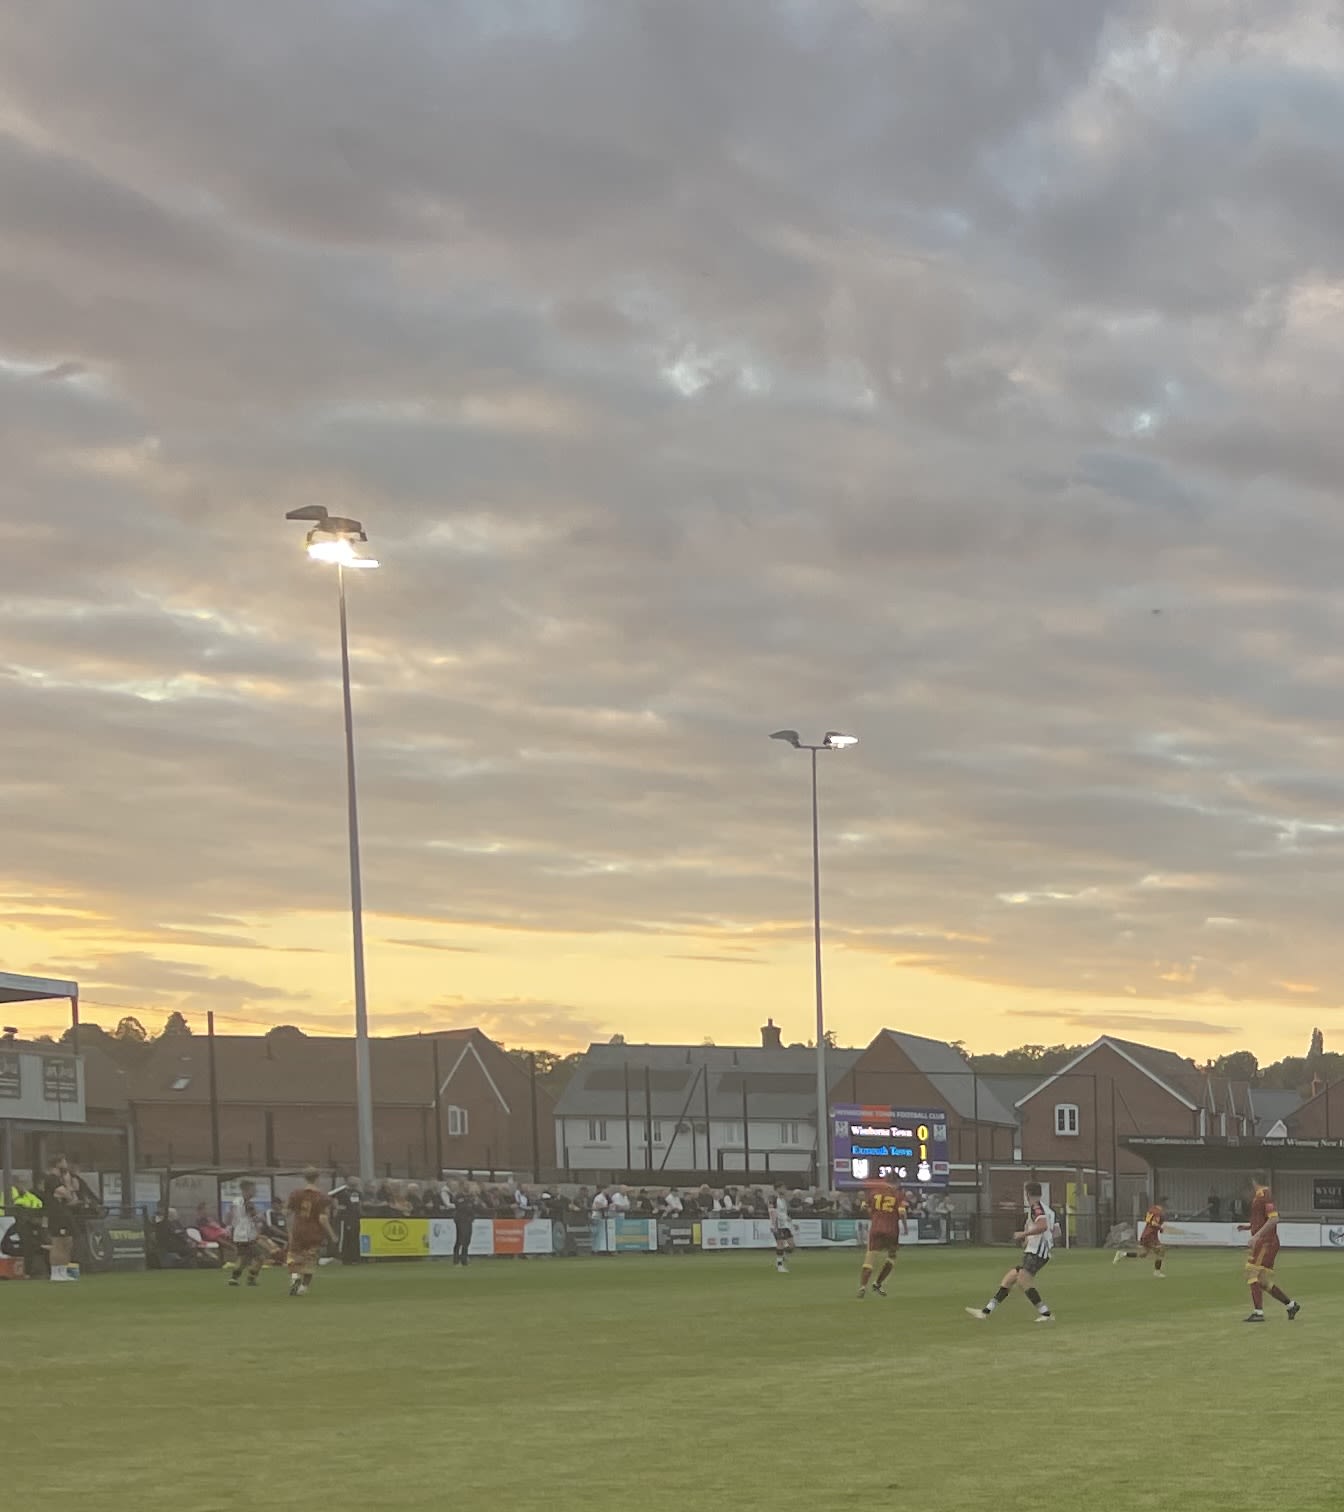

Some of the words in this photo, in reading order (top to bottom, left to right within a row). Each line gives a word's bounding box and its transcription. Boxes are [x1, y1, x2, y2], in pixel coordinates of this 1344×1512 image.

[896, 1111, 928, 1119] FOOTBALL
[928, 1112, 945, 1120] CLUB
[890, 1126, 913, 1137] Town
[916, 1125, 928, 1141] 0
[890, 1146, 913, 1156] Town
[919, 1144, 927, 1160] 1
[873, 1194, 897, 1212] 12
